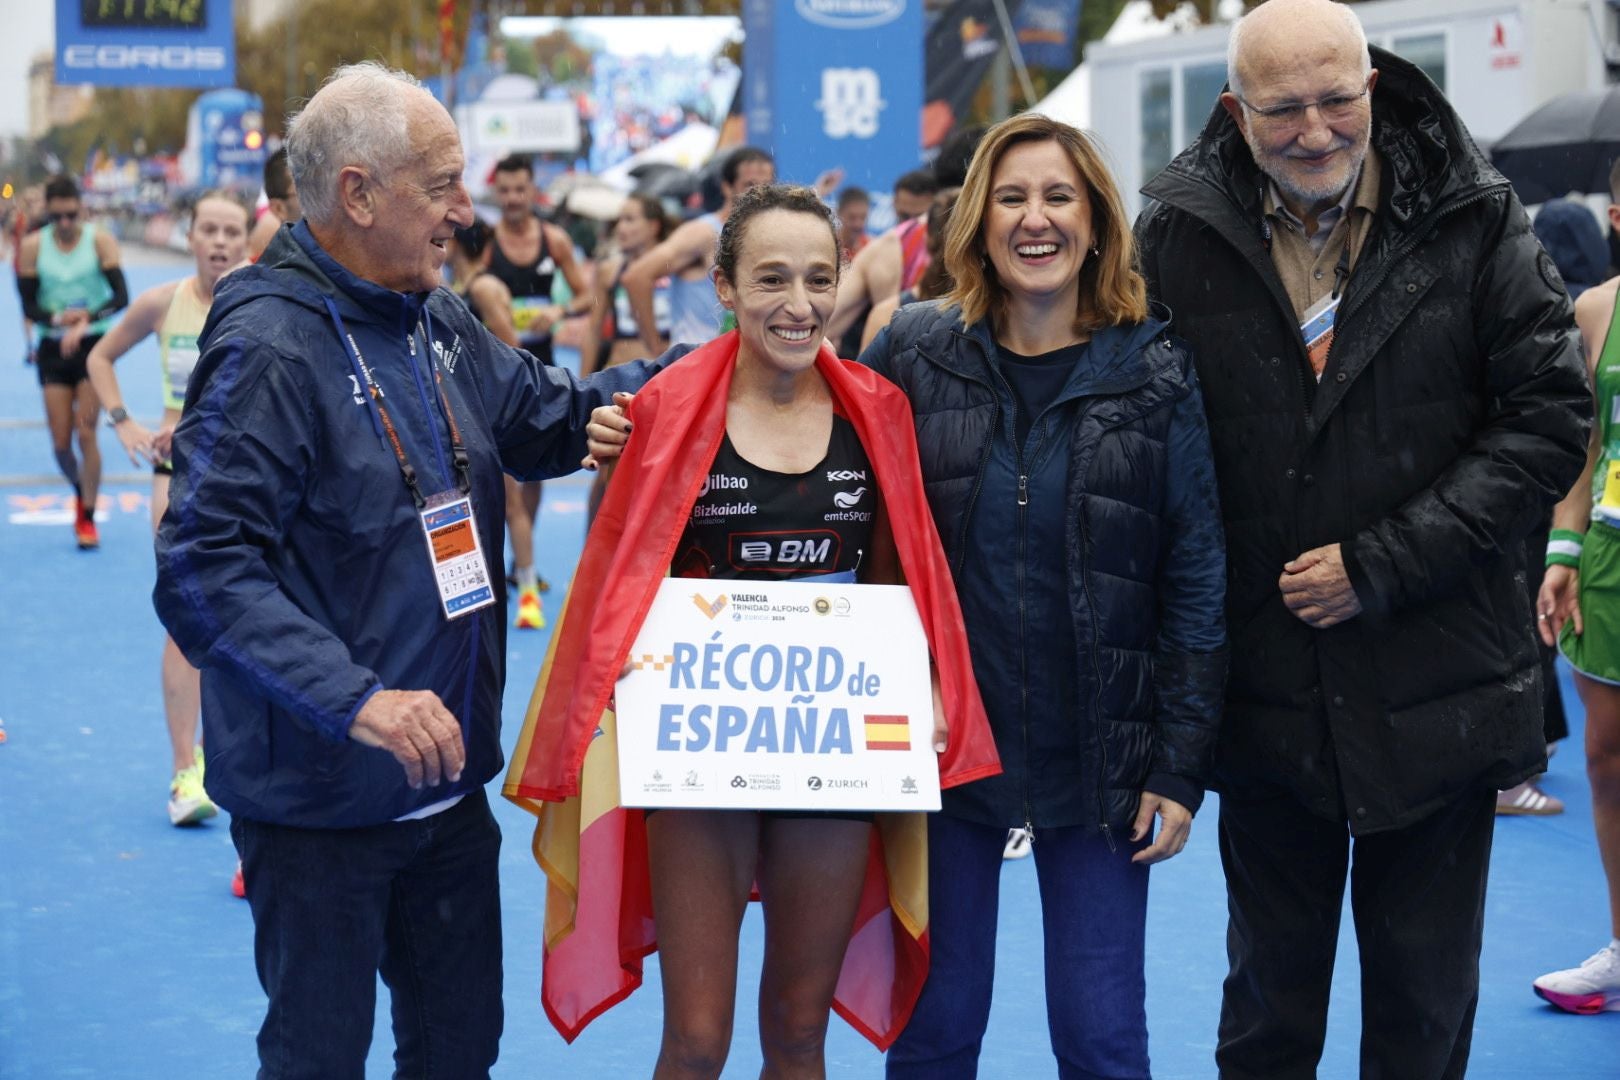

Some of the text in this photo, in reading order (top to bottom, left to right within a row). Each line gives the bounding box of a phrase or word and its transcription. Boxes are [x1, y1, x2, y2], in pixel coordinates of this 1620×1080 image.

[64, 45, 226, 70] COROS
[694, 502, 757, 517] Bizkaialde
[824, 511, 871, 521] emteSPORT
[777, 538, 831, 563] BM
[731, 594, 768, 602] VALENCIA
[772, 605, 809, 613] ALFONSO
[669, 630, 881, 696] RÉCORD de
[657, 695, 853, 754] ESPAÑA
[827, 780, 868, 788] ZURICH
